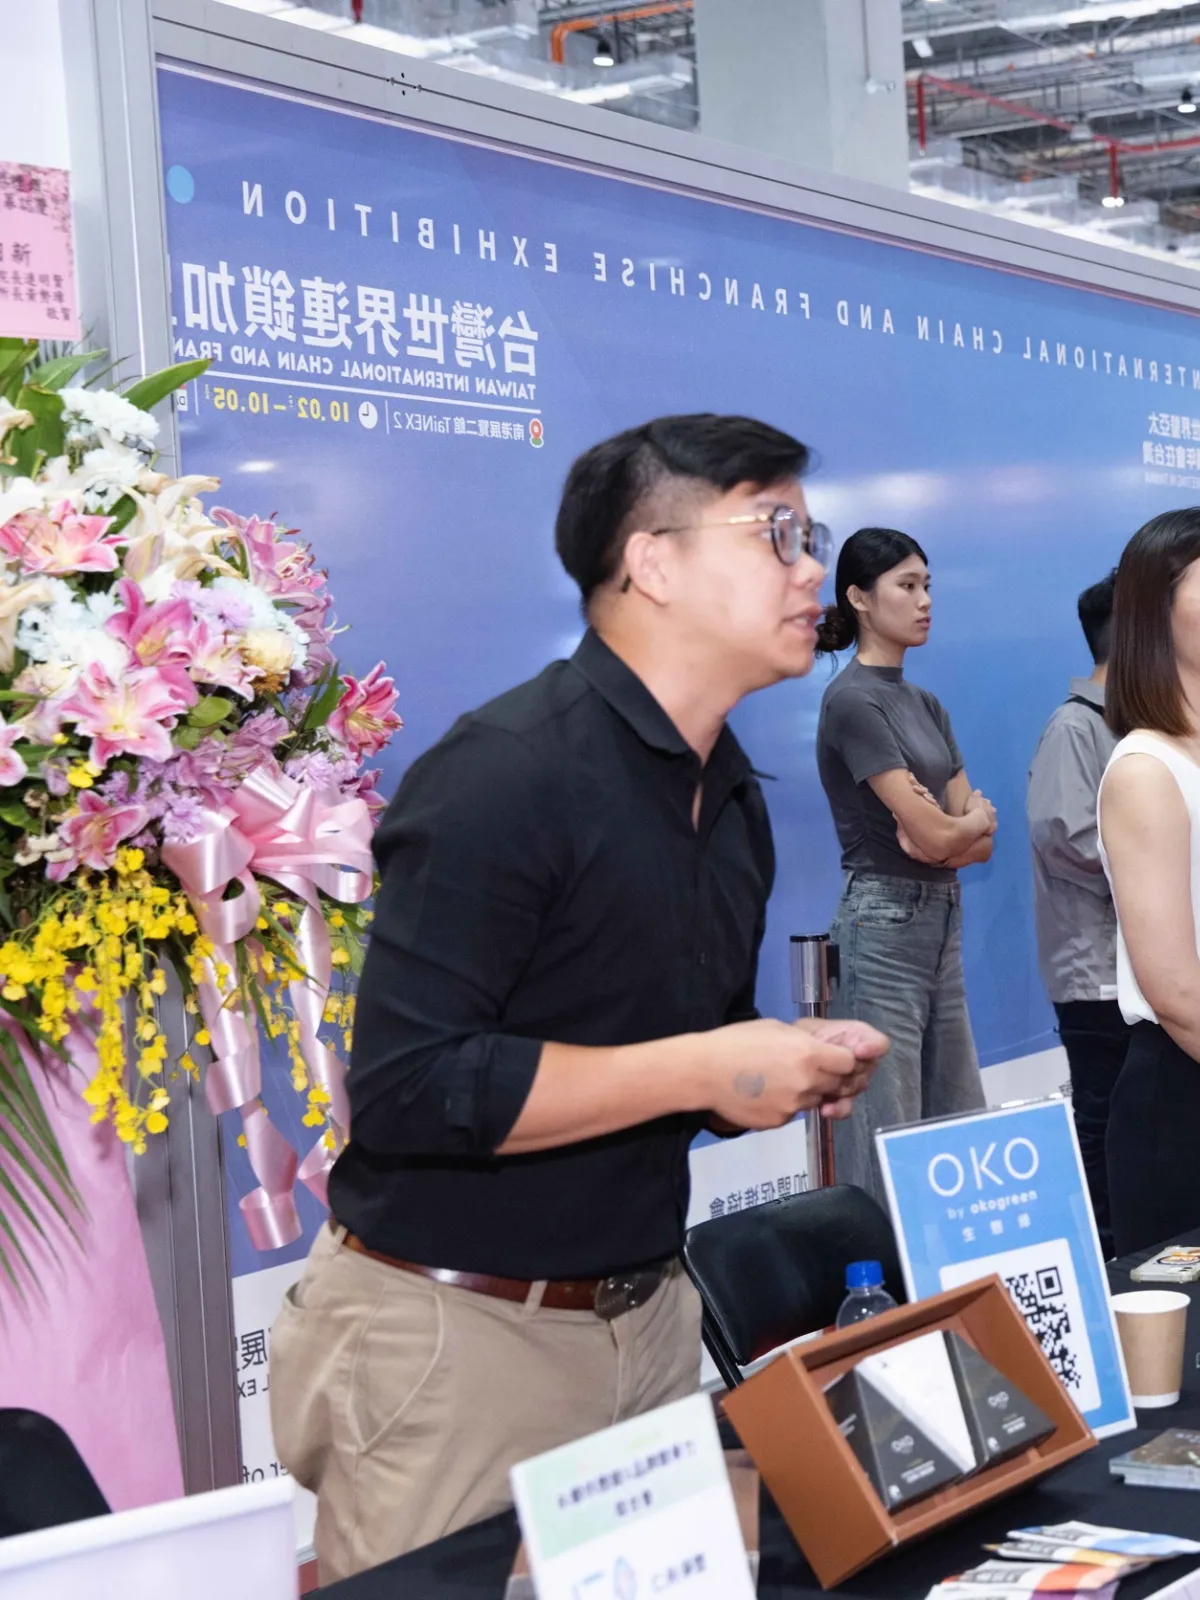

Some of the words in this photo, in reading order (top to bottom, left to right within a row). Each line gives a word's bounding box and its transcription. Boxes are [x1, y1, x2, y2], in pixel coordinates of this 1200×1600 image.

[927, 1137, 1040, 1198] OKO
[947, 1206, 965, 1221] by
[969, 1188, 1039, 1215] okogreen
